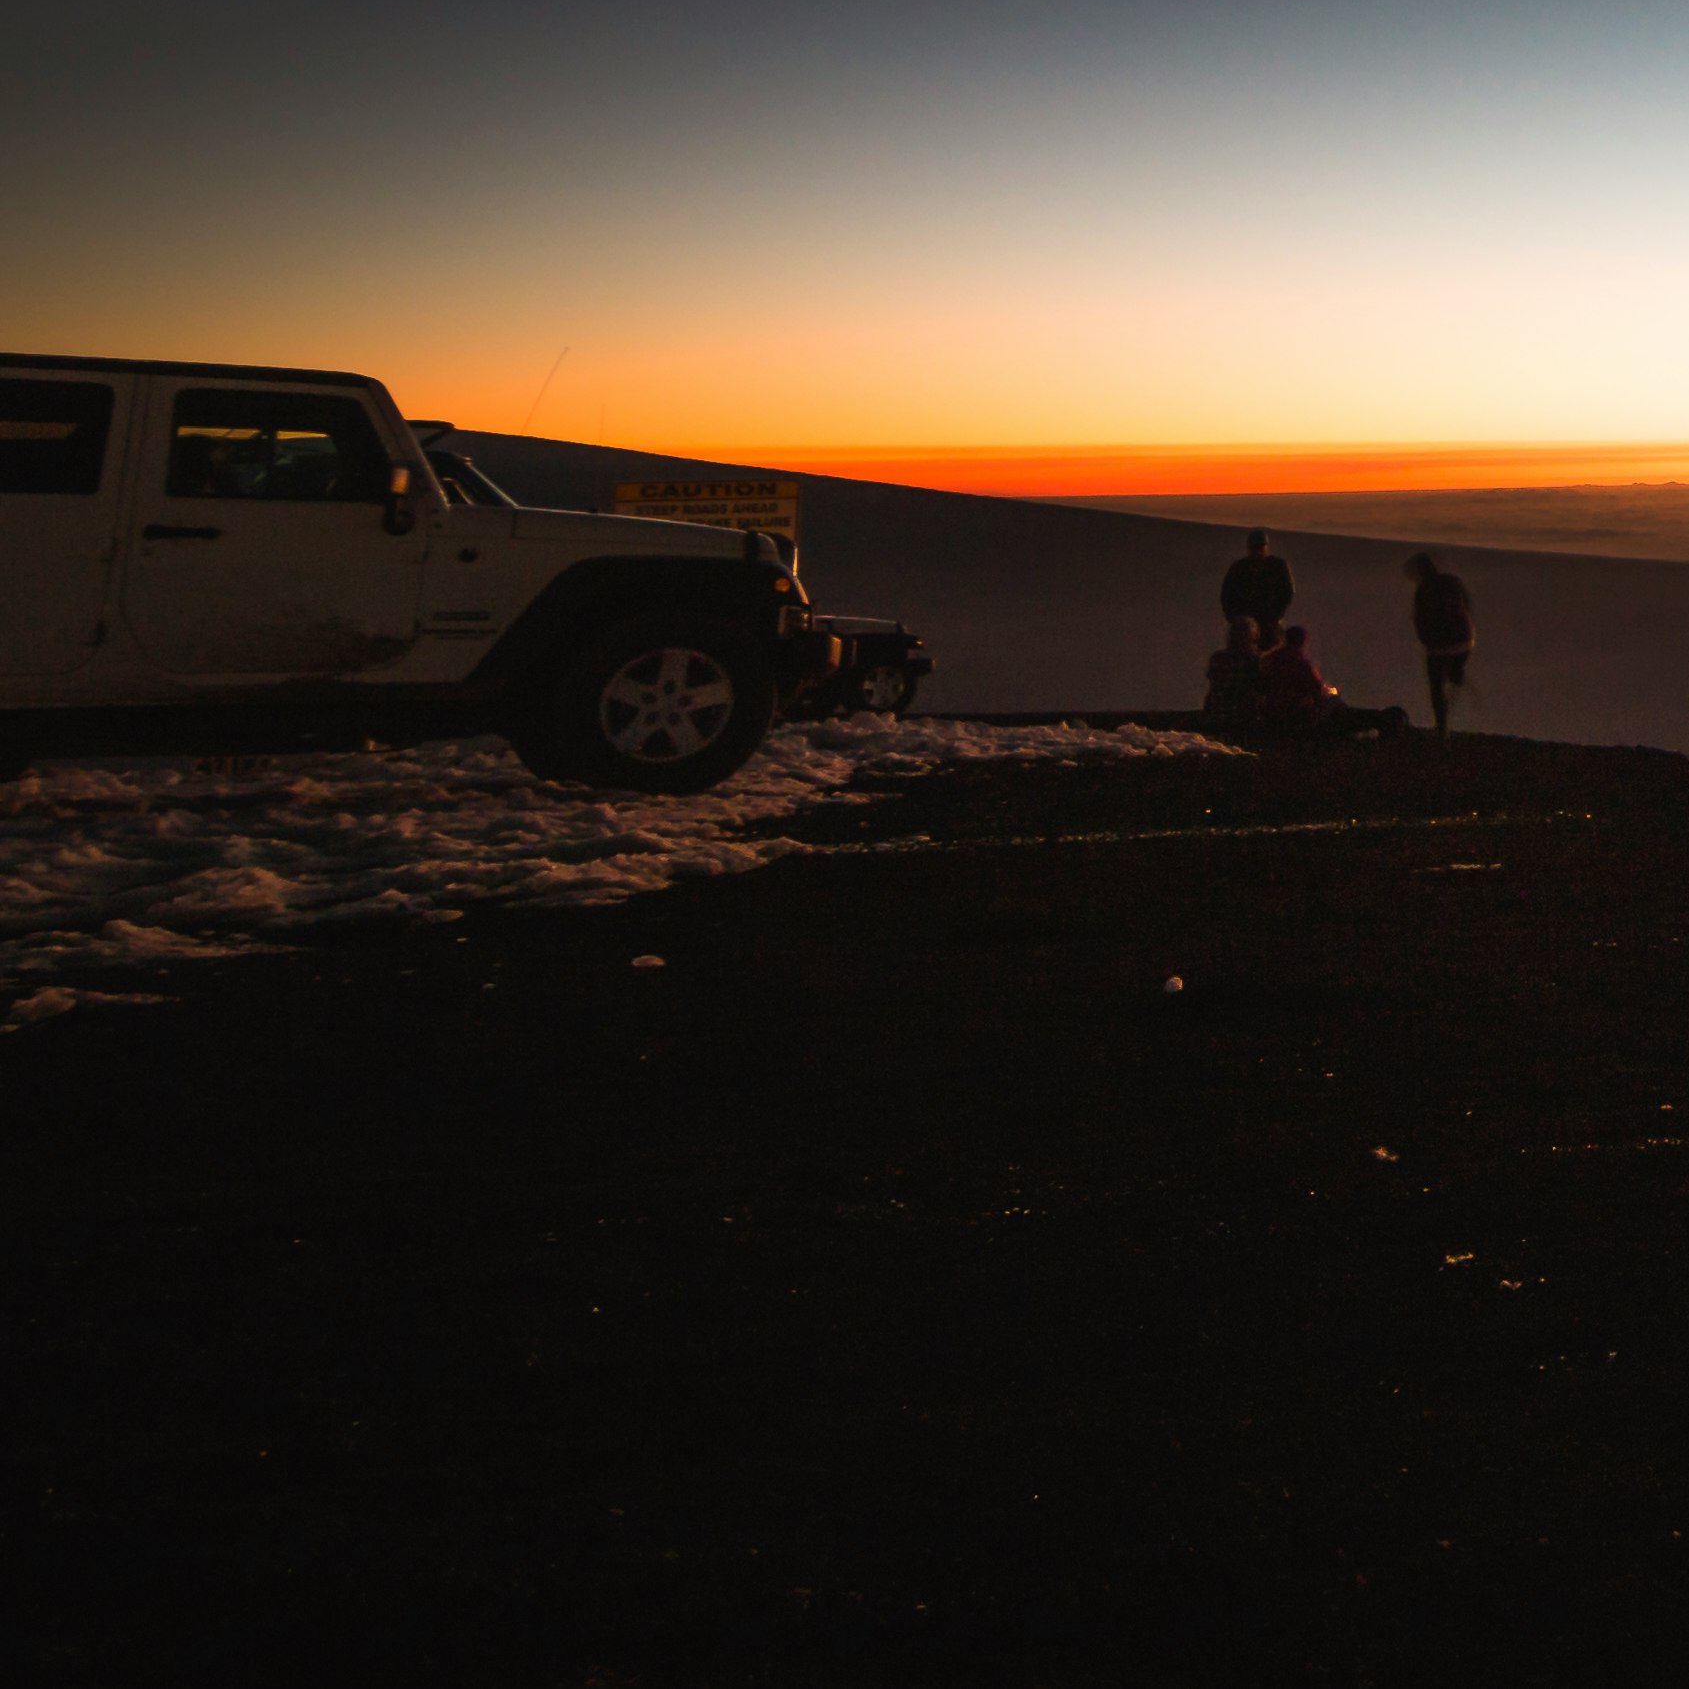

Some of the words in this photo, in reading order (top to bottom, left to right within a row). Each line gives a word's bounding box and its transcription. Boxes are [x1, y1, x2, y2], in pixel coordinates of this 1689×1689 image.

[640, 483, 777, 497] CAUTION
[636, 505, 678, 515] STEEP
[683, 504, 728, 514] ROADS
[732, 503, 778, 513] AHEAD
[737, 517, 791, 527] FAILURE
